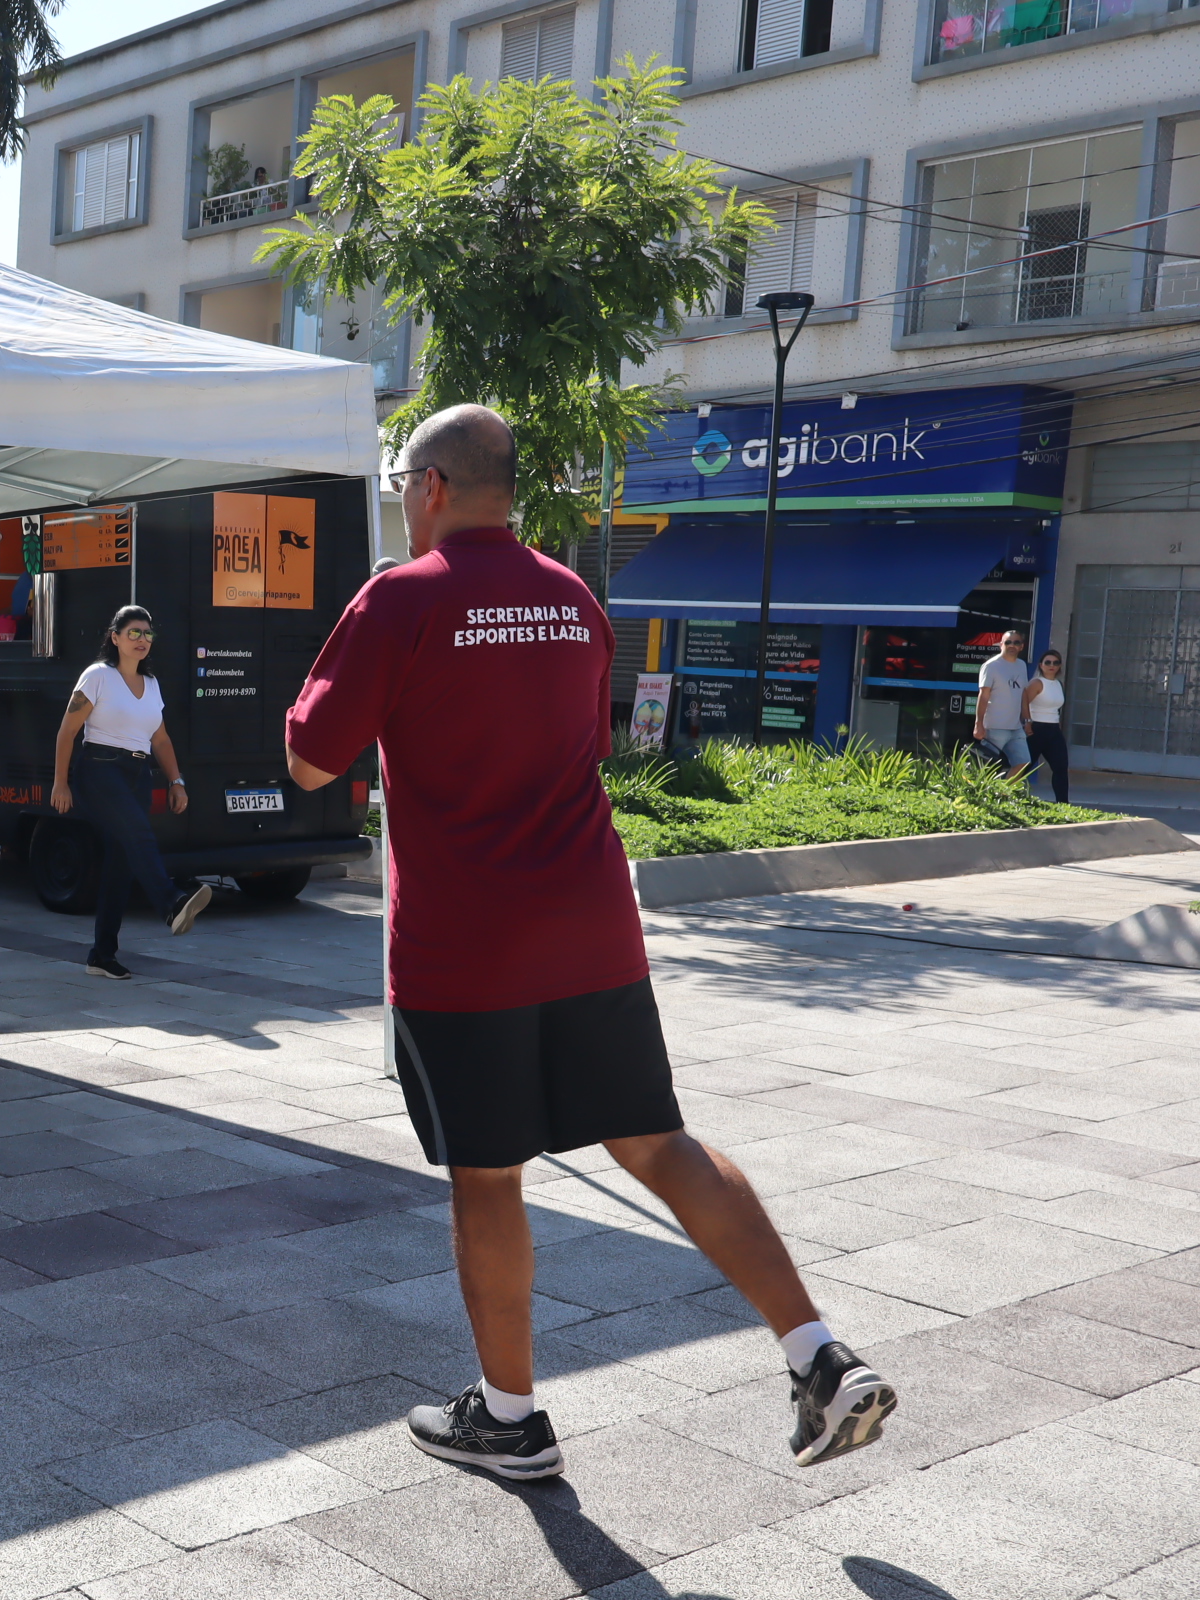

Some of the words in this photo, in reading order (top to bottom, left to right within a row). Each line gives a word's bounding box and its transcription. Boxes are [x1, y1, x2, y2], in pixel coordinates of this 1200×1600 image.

[741, 418, 925, 477] agibank
[44, 532, 53, 541] ESB
[44, 546, 56, 554] HAZY
[1168, 541, 1183, 554] 21
[44, 559, 56, 567] SOUR
[237, 589, 301, 601] cervejariapangea
[466, 606, 560, 625] SECRETARIA
[561, 605, 580, 622] DE
[454, 626, 535, 647] ESPORTES
[538, 625, 547, 642] E
[549, 624, 590, 644] LAZER
[956, 643, 977, 652] Pague
[780, 650, 789, 658] de
[789, 651, 805, 659] Vida
[206, 668, 245, 677] @lakombeta
[699, 681, 733, 689] Empréstimo
[774, 684, 792, 692] Taxas
[204, 688, 218, 697] (19)
[219, 687, 257, 696] 99149-8970
[701, 702, 727, 710] Antecipe
[231, 795, 278, 810] BGY1F71
